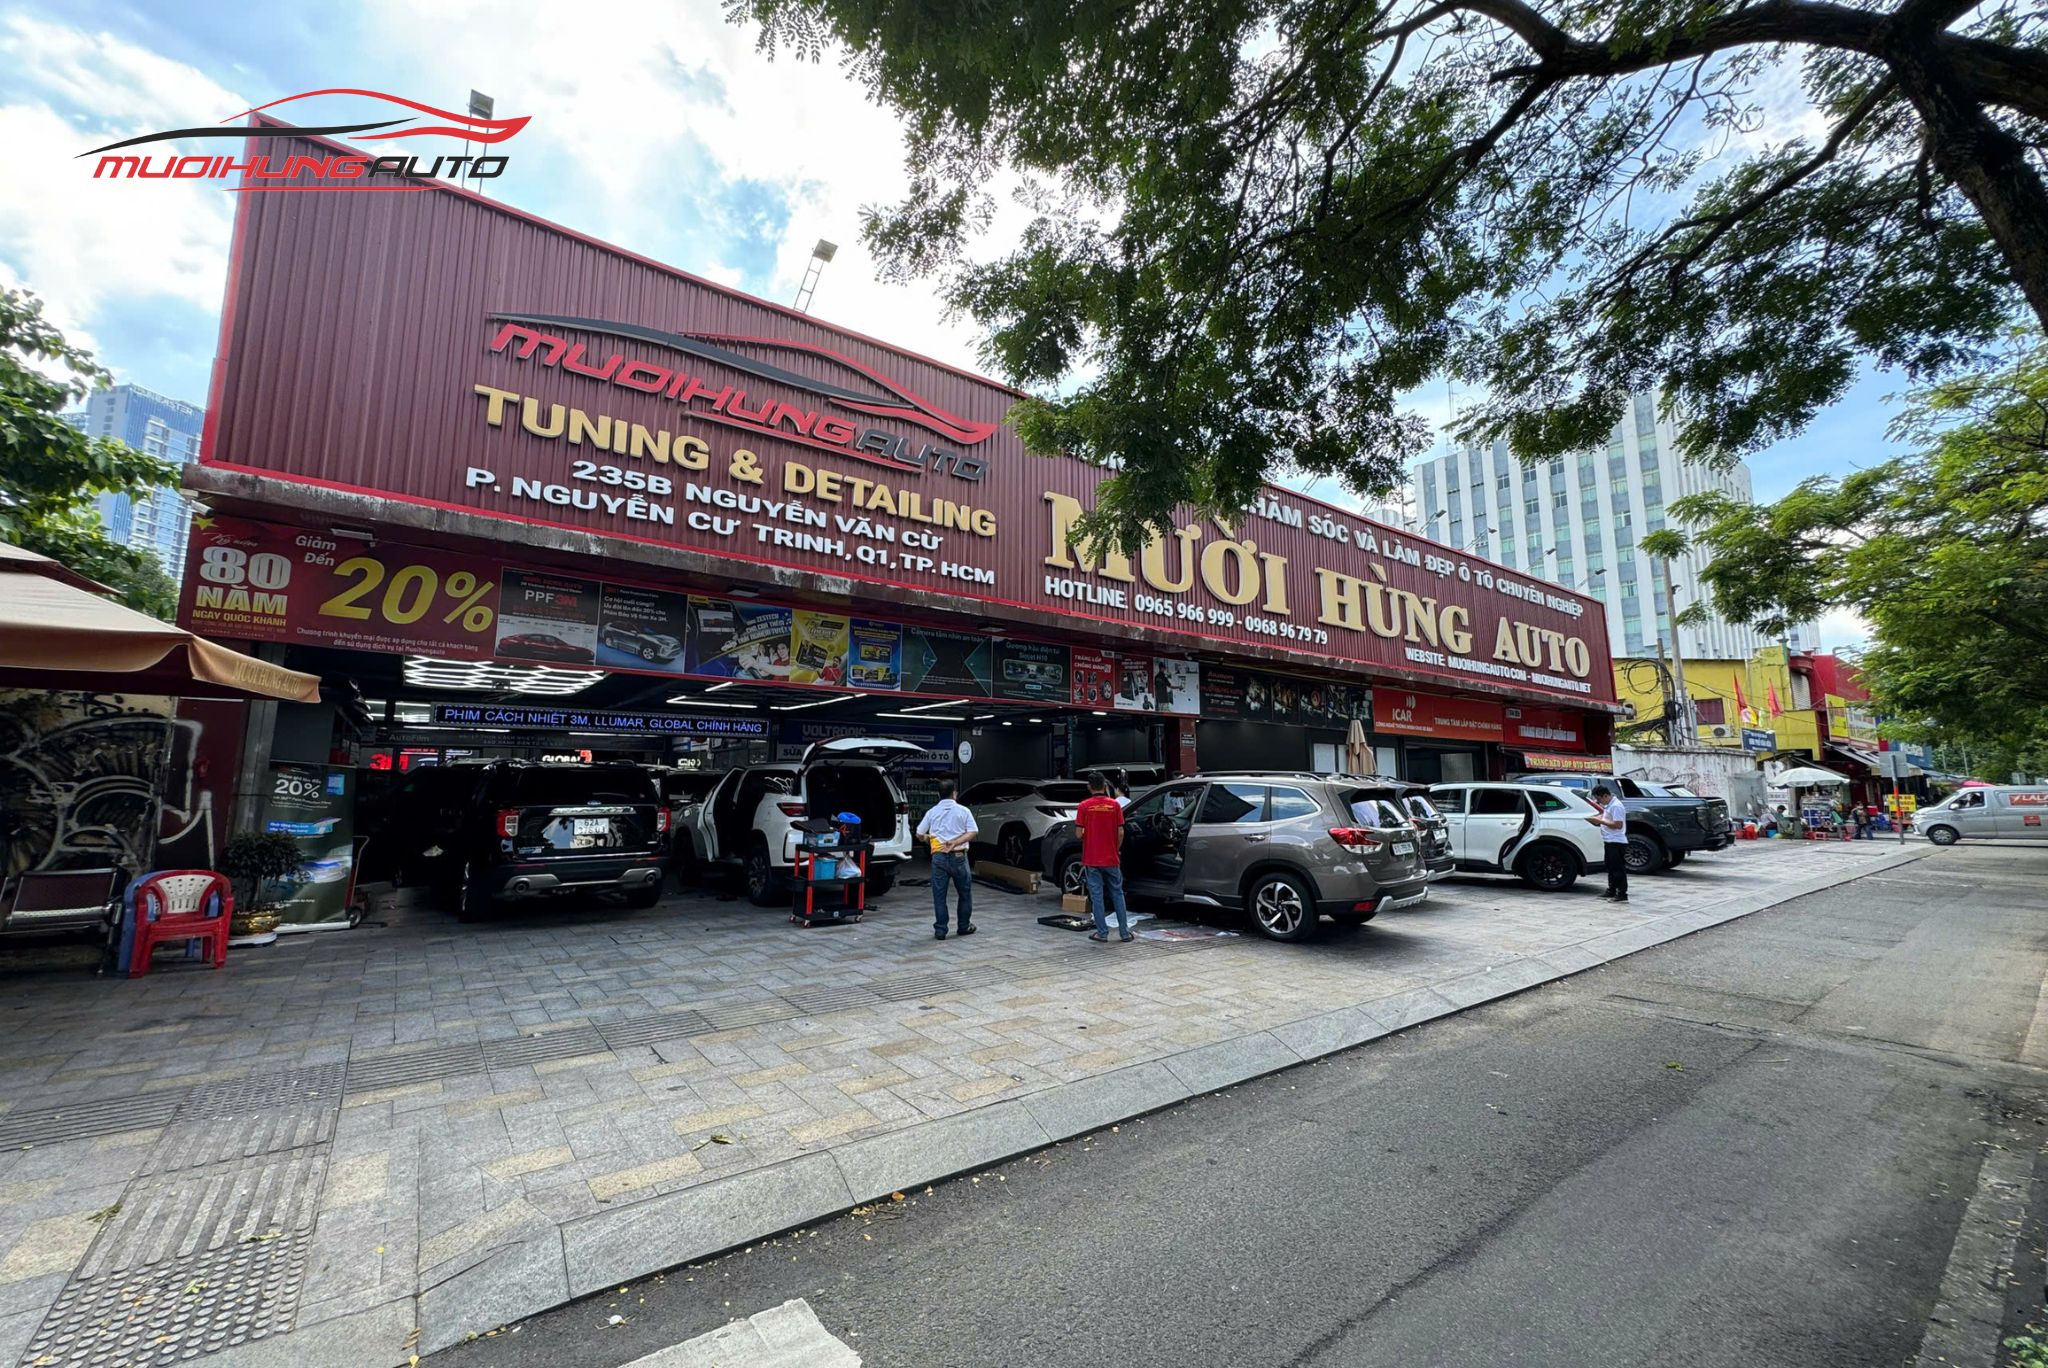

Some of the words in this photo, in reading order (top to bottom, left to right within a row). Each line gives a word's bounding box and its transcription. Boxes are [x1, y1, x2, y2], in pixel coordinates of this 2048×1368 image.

[474, 384, 710, 471] TUNING
[729, 449, 764, 485] &
[784, 461, 996, 537] DETAILING
[466, 466, 501, 492] P.
[512, 475, 674, 524] NGUYỄN
[688, 511, 741, 535] CƯ
[941, 561, 995, 584] HCM
[572, 460, 673, 495] 235B
[685, 482, 827, 528] NGUYỄN
[834, 515, 895, 542] VĂN
[901, 529, 944, 550] CỪ
[295, 535, 337, 551] Giảm
[304, 552, 335, 567] Đến
[1240, 494, 1302, 528] HĂM
[1308, 514, 1349, 543] SÓC
[1354, 527, 1378, 554] VÀ
[1383, 539, 1421, 567] LÀM
[1424, 553, 1455, 578] ĐẸP
[1458, 562, 1471, 582] Ô
[1473, 569, 1494, 589] TÔ
[1496, 577, 1545, 606] CHUYÊN
[1546, 594, 1583, 620] NGHIỆP
[200, 546, 292, 590] 80
[1044, 491, 1290, 615] MƯỜI
[1315, 562, 1473, 654] HÙNG
[1492, 617, 1590, 677] AUTO
[195, 584, 288, 616] NĂM
[318, 557, 495, 632] 20%
[524, 589, 555, 604] PPF
[1135, 594, 1174, 617] 0965
[1177, 602, 1204, 622] 966
[1207, 608, 1234, 627] 999
[1245, 615, 1278, 636] 0968
[444, 709, 480, 721] PHIM
[484, 709, 524, 722] CÁCH
[649, 718, 694, 730] GLOBAL
[696, 720, 731, 732] CHÍNH
[1392, 707, 1412, 721] ICAR
[274, 779, 320, 798] 20%
